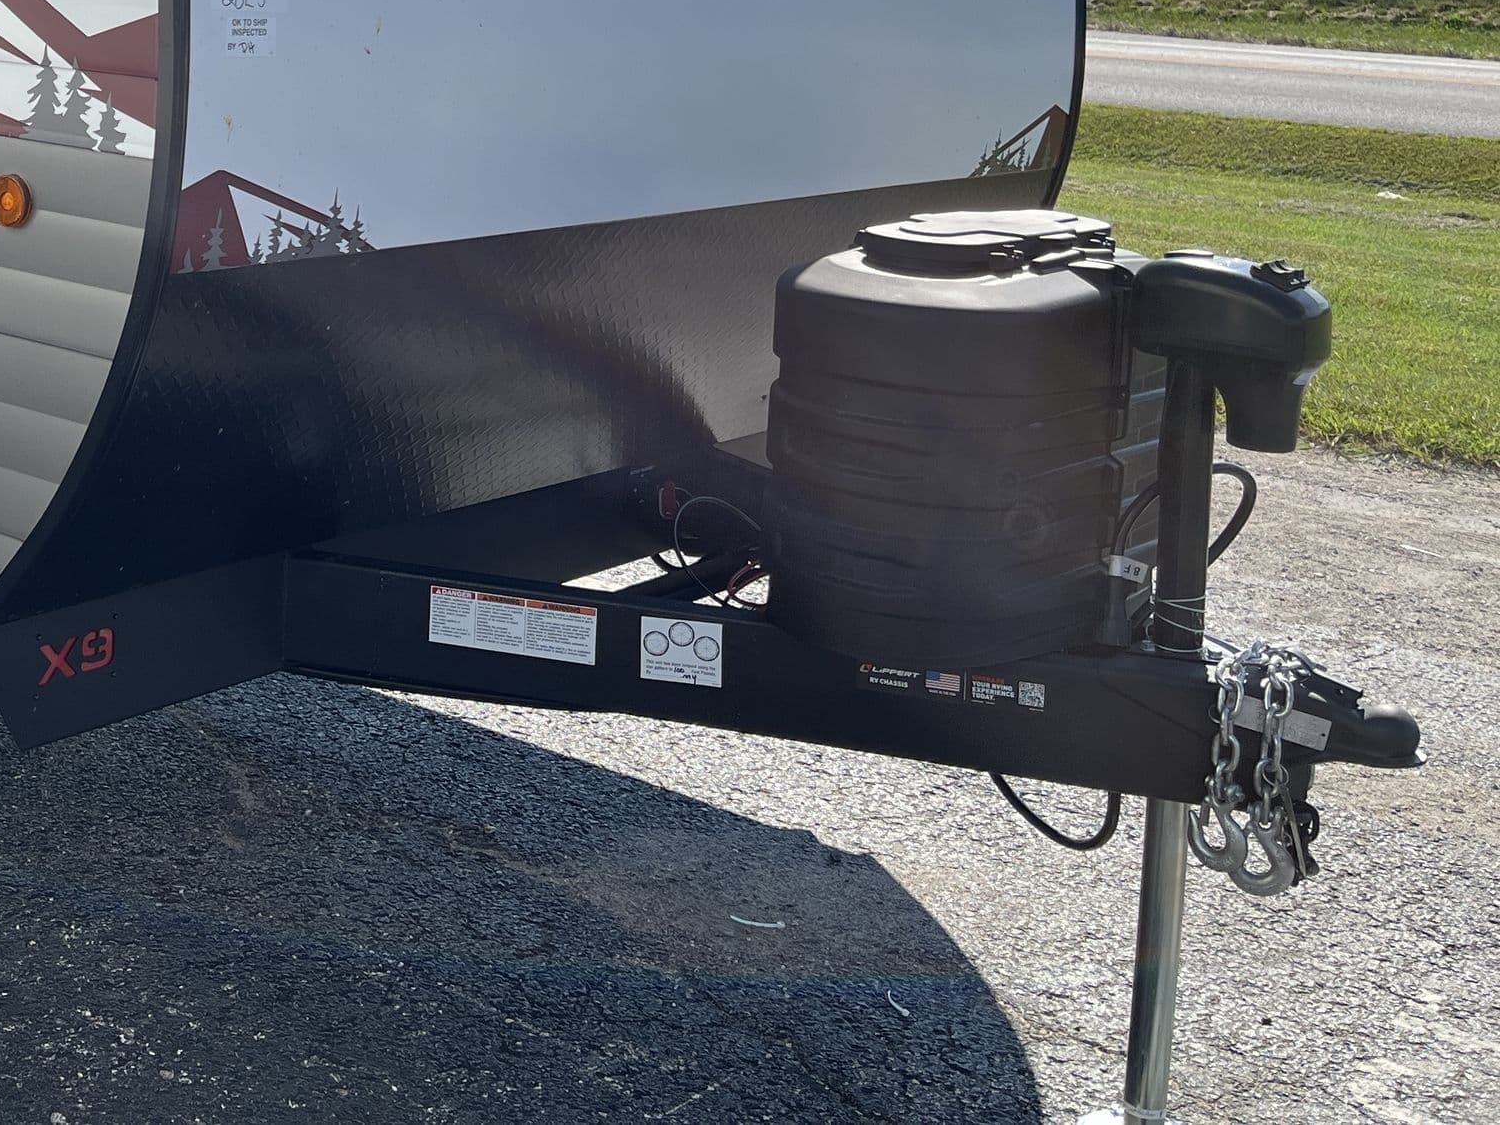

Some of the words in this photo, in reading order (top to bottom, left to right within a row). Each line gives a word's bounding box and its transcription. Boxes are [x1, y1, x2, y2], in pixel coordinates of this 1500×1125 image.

[243, 18, 252, 27] TO
[253, 18, 268, 27] SHIP
[231, 28, 268, 36] INSPECTED
[227, 42, 236, 51] BY
[441, 588, 472, 599] DANGER
[872, 666, 921, 679] LIPPERT
[869, 676, 879, 684] RV
[879, 678, 909, 688] CHASSIS
[972, 680, 990, 689] YOUR
[972, 686, 1015, 698] EXPERIENCE
